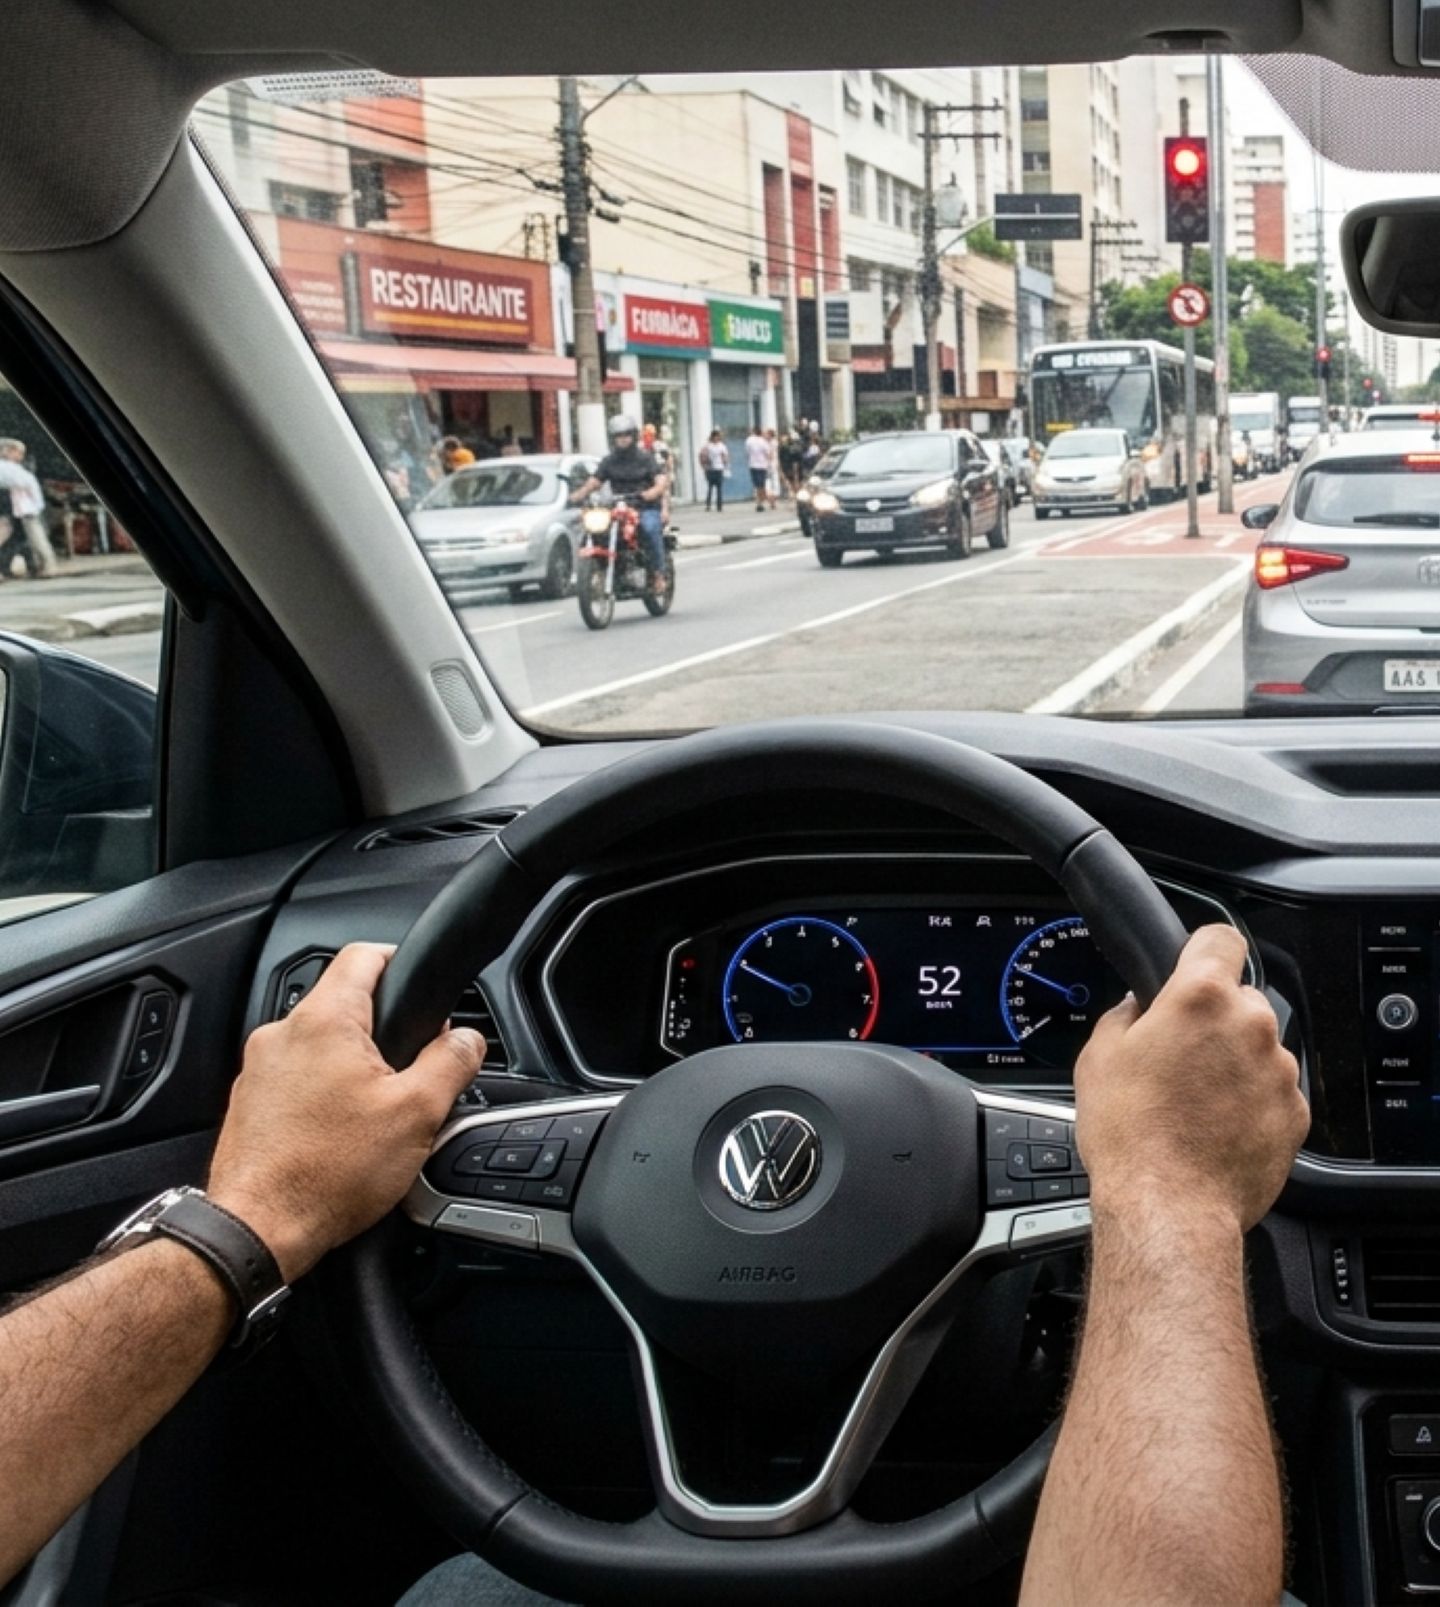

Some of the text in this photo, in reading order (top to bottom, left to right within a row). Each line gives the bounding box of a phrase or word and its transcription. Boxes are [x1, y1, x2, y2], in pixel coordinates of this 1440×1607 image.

[369, 268, 528, 320] RESTAURANTE
[918, 966, 962, 996] 52
[717, 1267, 798, 1283] AIRBAG
